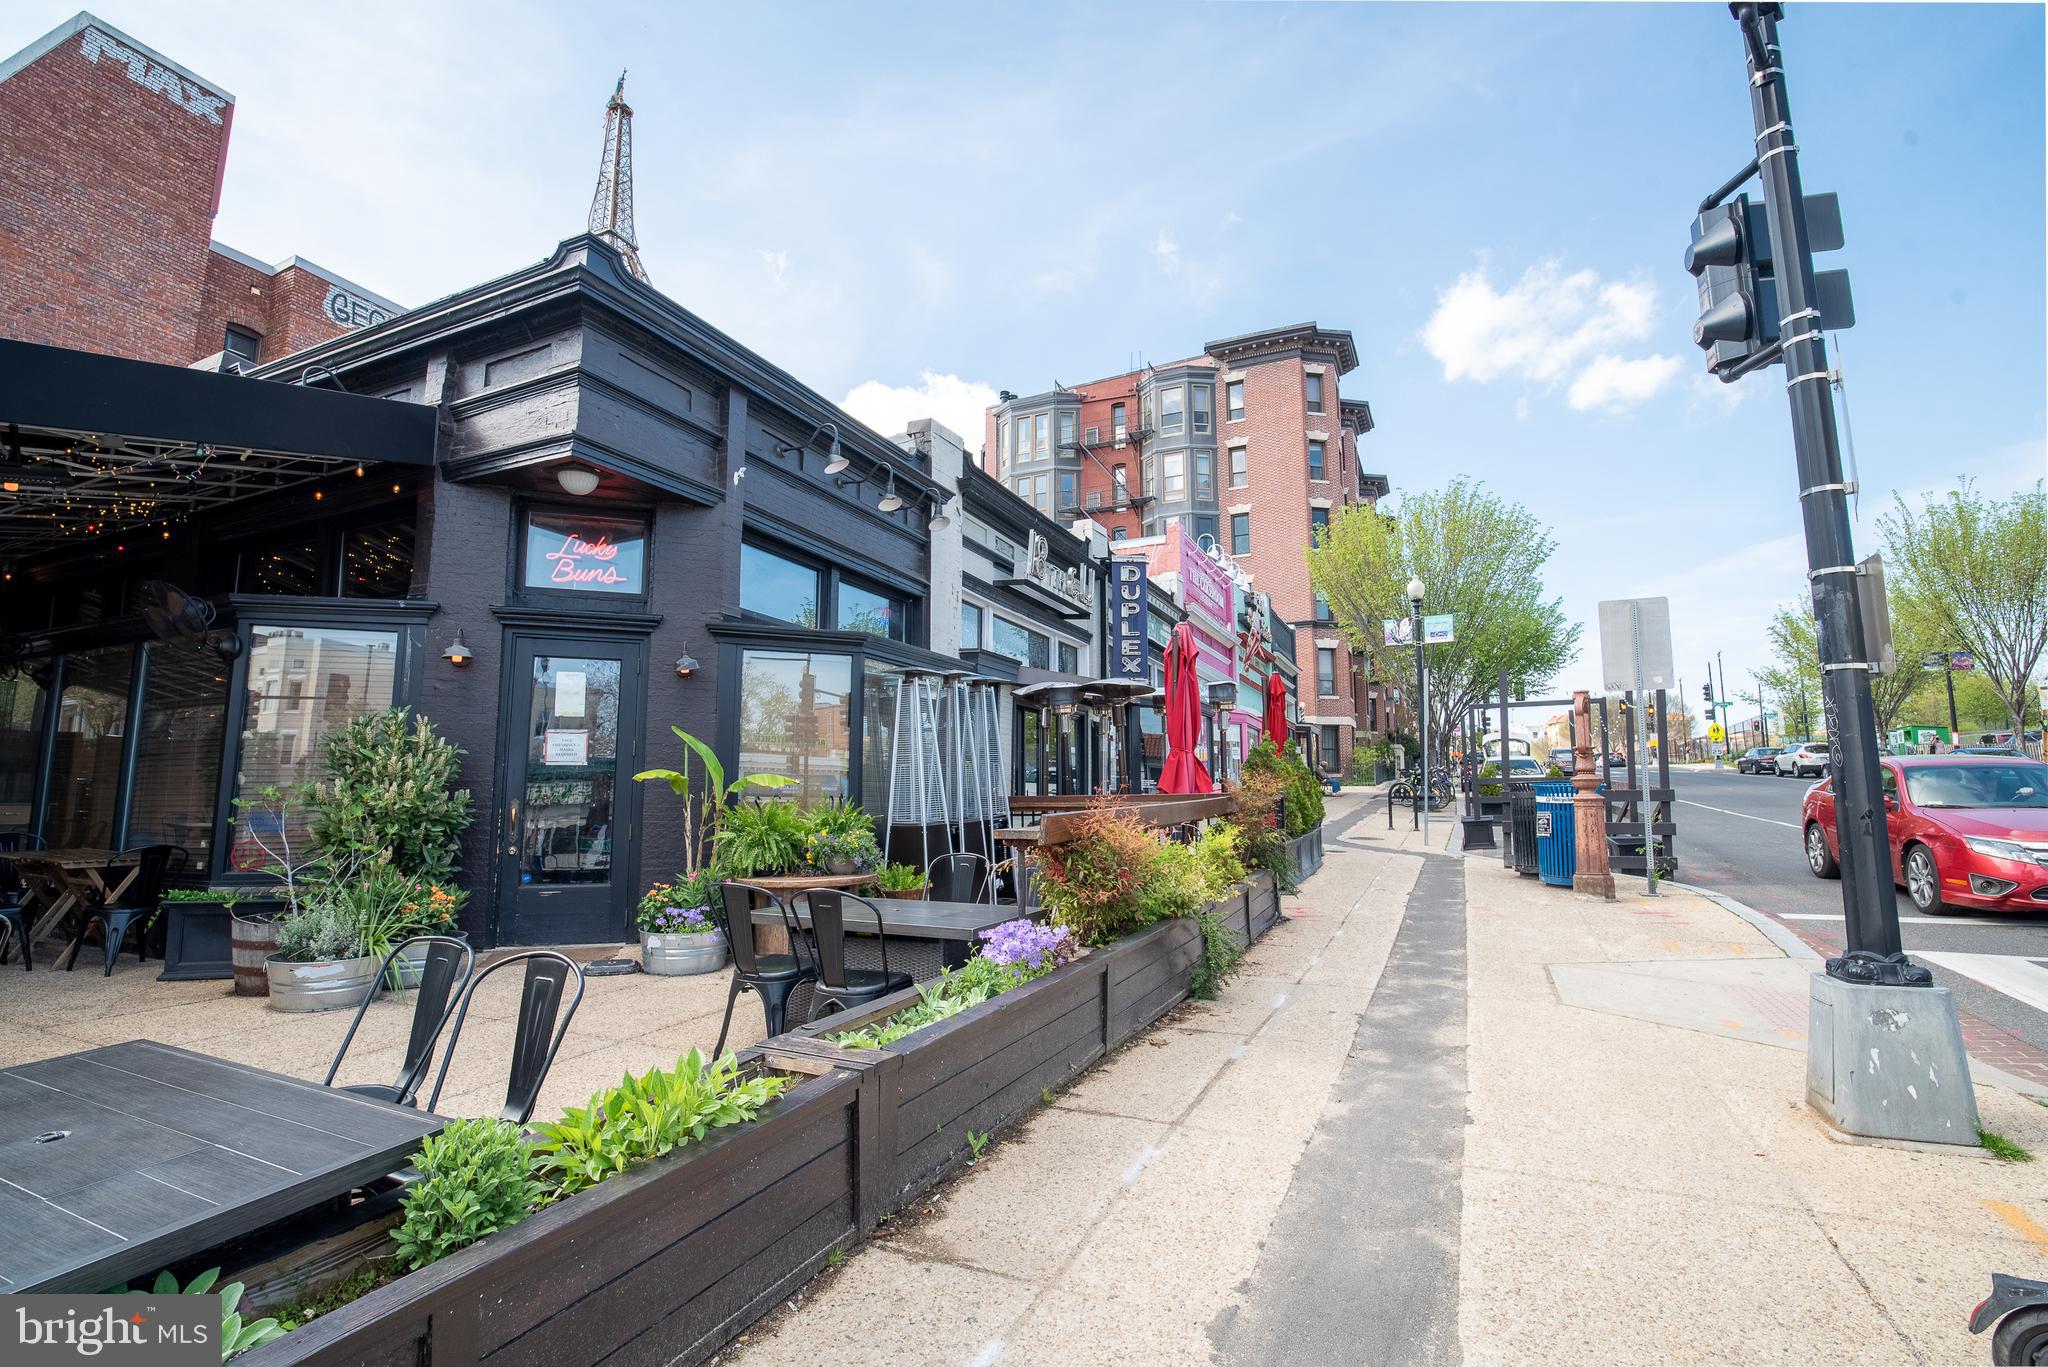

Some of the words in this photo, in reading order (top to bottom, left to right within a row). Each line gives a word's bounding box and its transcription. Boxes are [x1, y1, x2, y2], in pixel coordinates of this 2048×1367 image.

[545, 534, 618, 560] Lucky
[551, 559, 628, 584] Buns
[1120, 565, 1142, 673] DUPLEX
